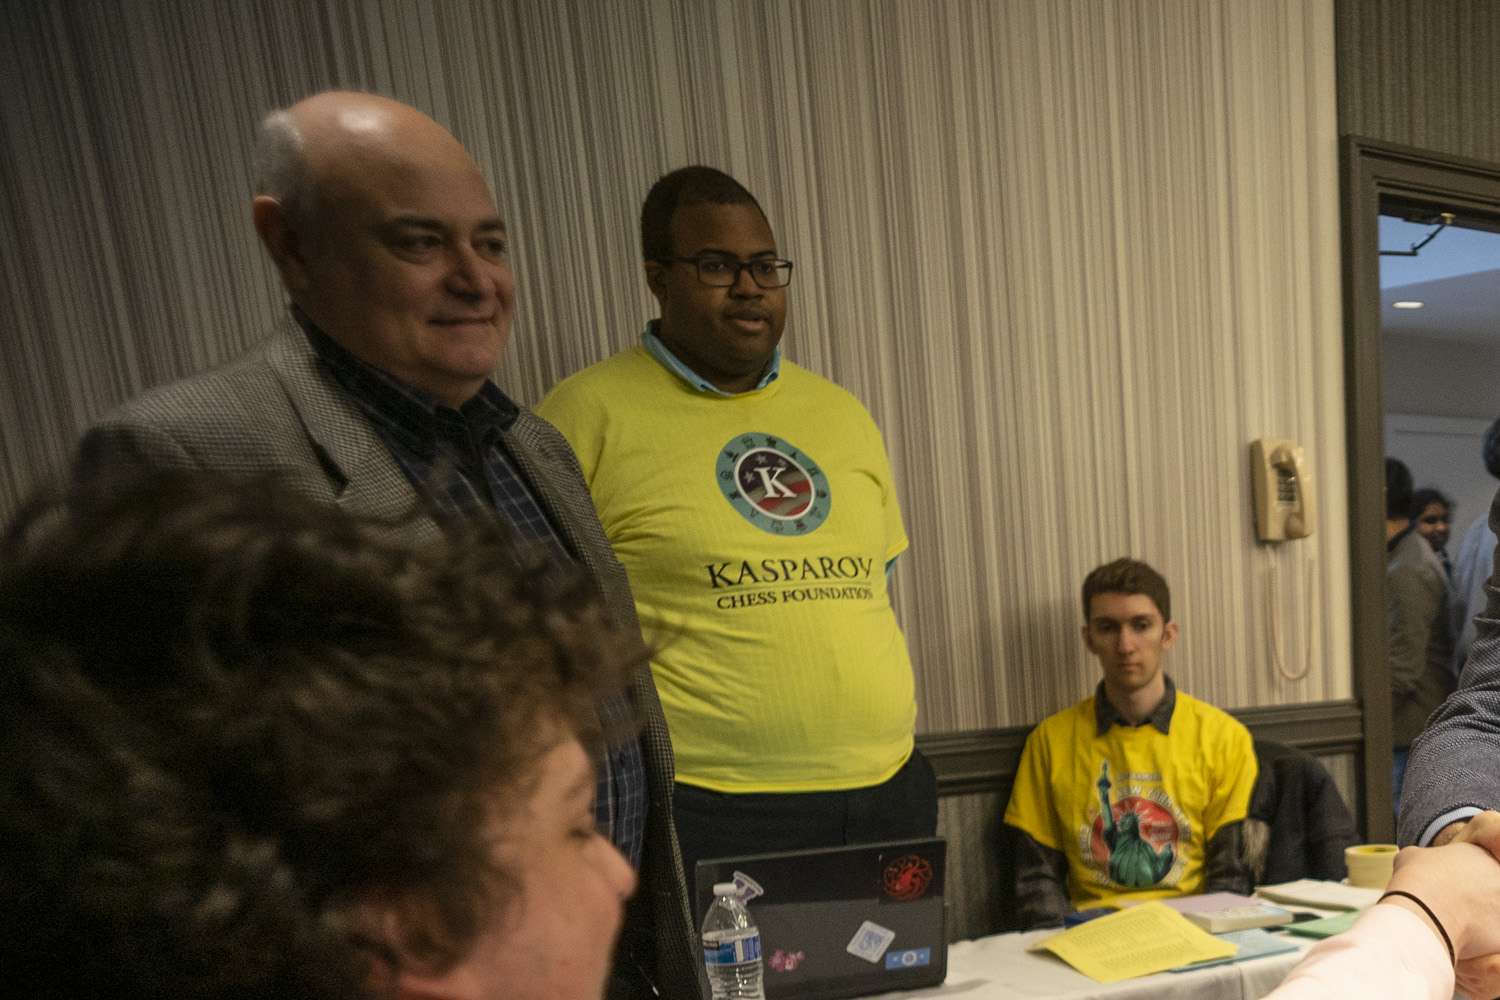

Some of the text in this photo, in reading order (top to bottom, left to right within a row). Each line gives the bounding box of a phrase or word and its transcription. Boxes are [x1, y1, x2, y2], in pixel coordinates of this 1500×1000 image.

[753, 466, 798, 499] K
[705, 556, 873, 588] KASPAROV
[716, 587, 873, 610] CHESS FOUNDATION
